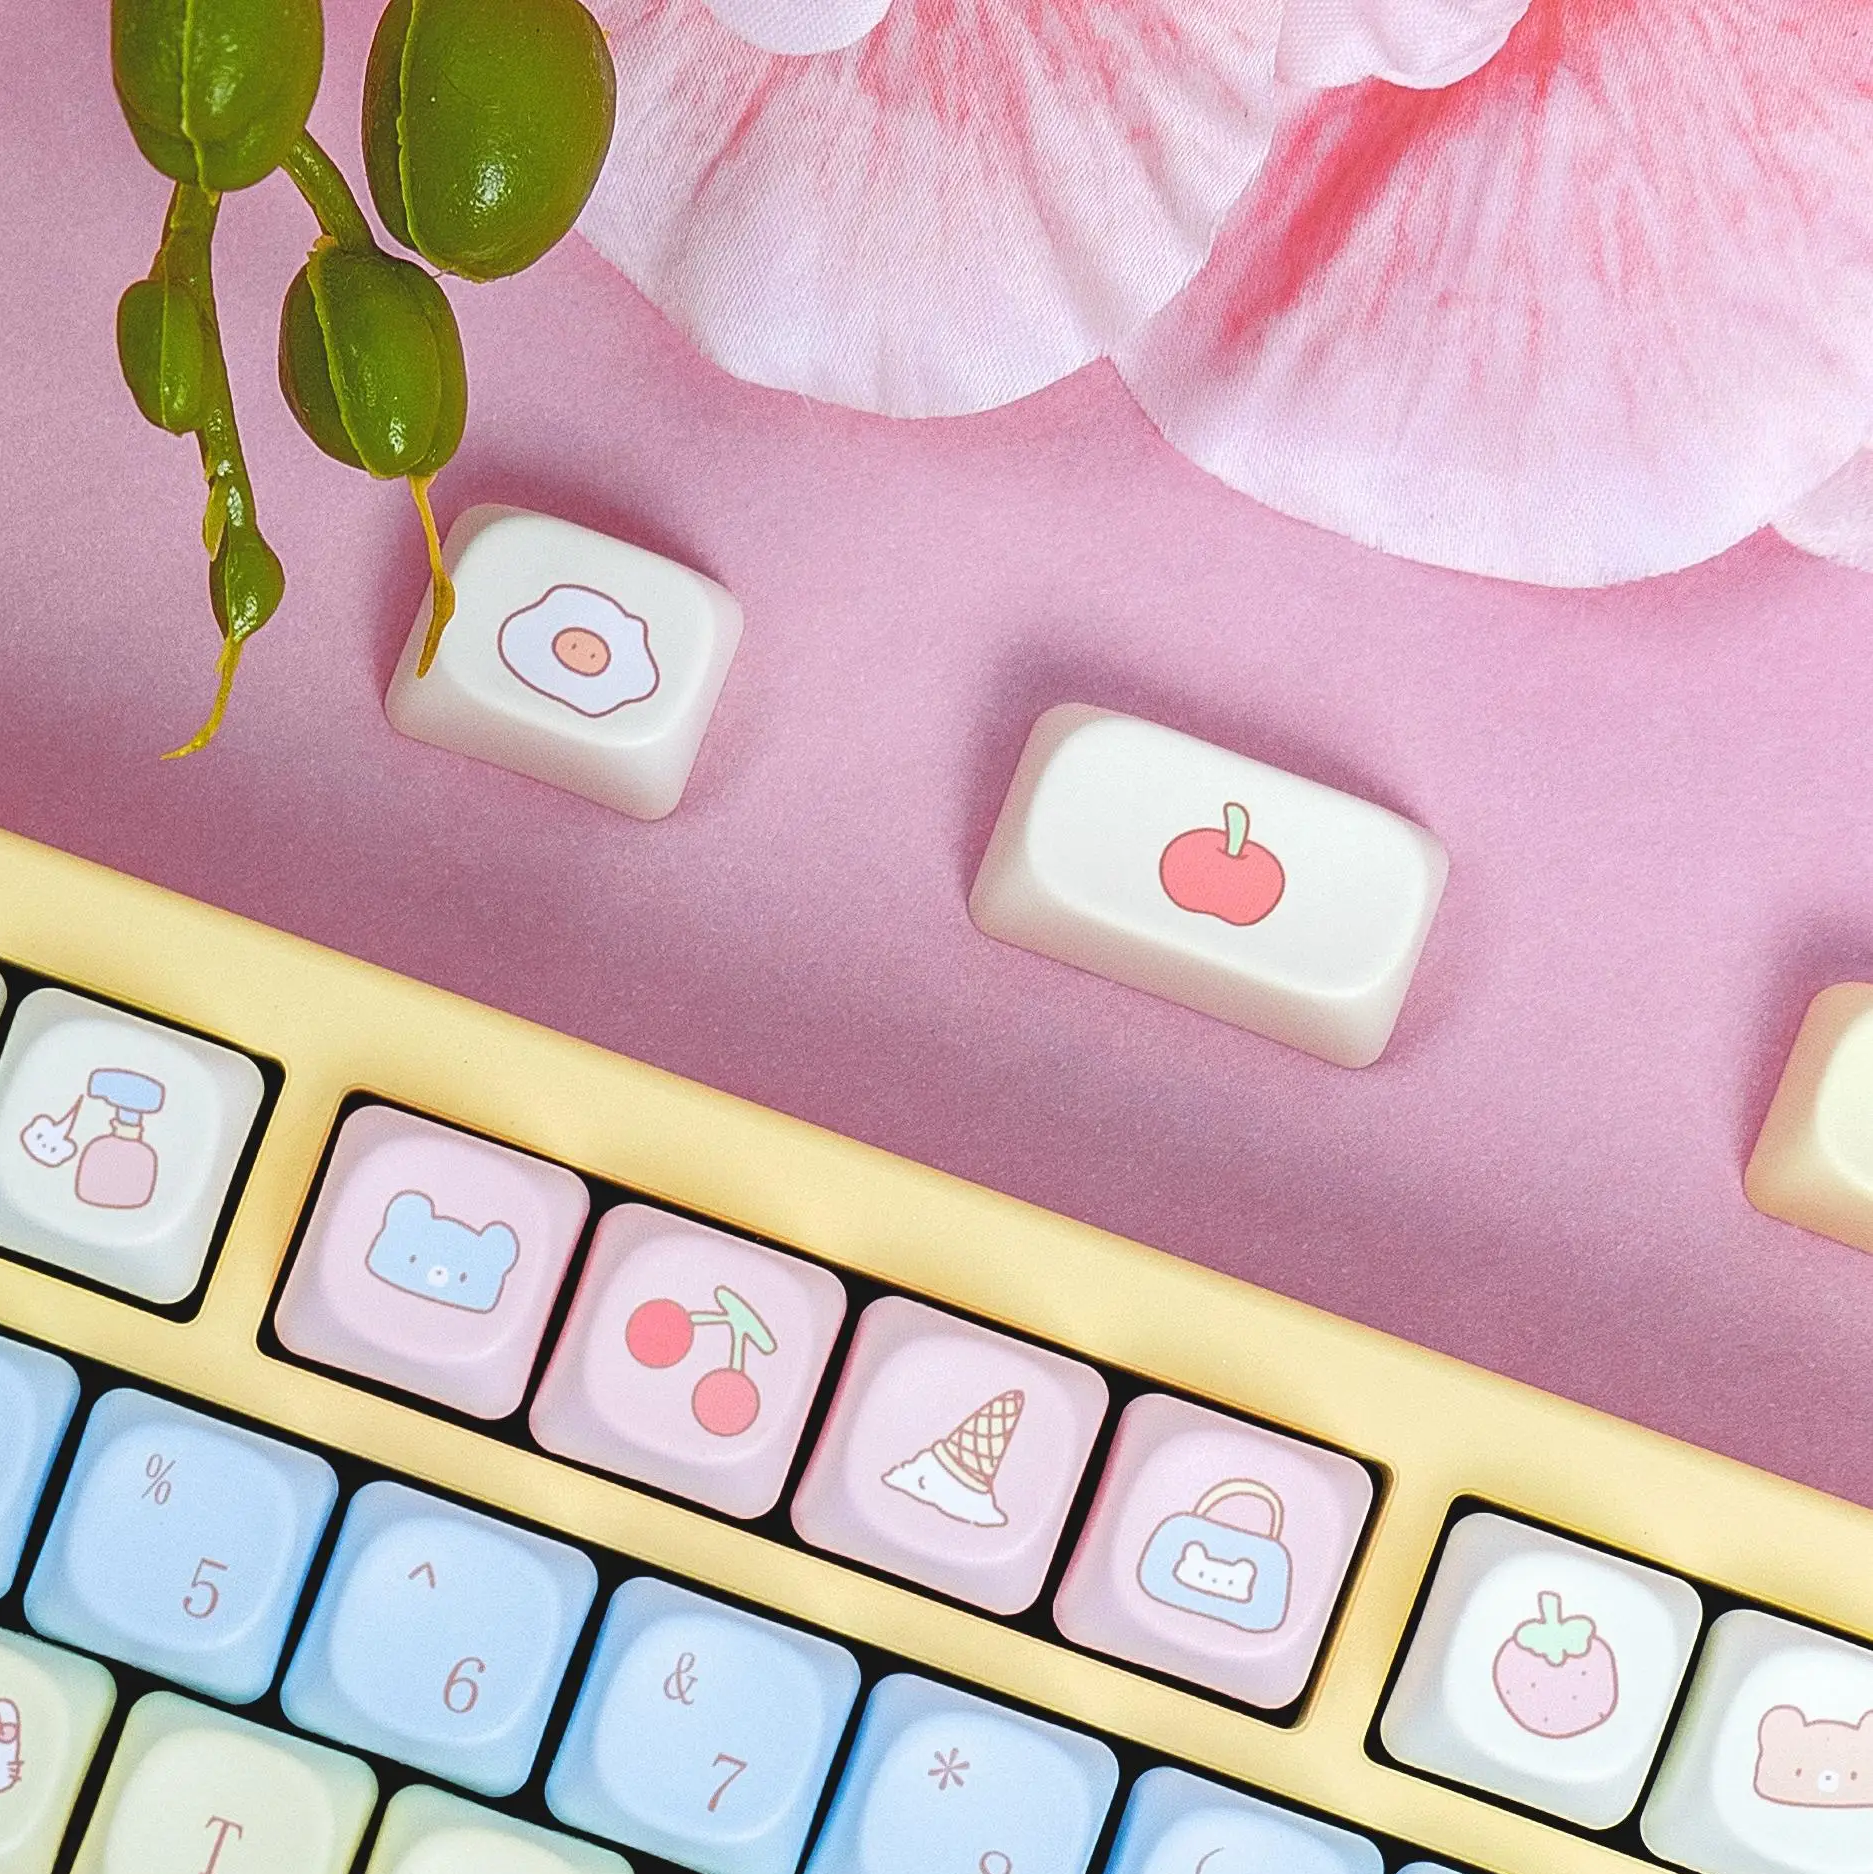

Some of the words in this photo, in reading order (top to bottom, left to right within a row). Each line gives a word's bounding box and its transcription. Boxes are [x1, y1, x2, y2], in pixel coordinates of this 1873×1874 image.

[145, 1453, 176, 1505] %
[182, 1558, 228, 1618] 5
[443, 1656, 486, 1714] 6
[662, 1652, 698, 1705] &
[706, 1753, 747, 1812] 7
